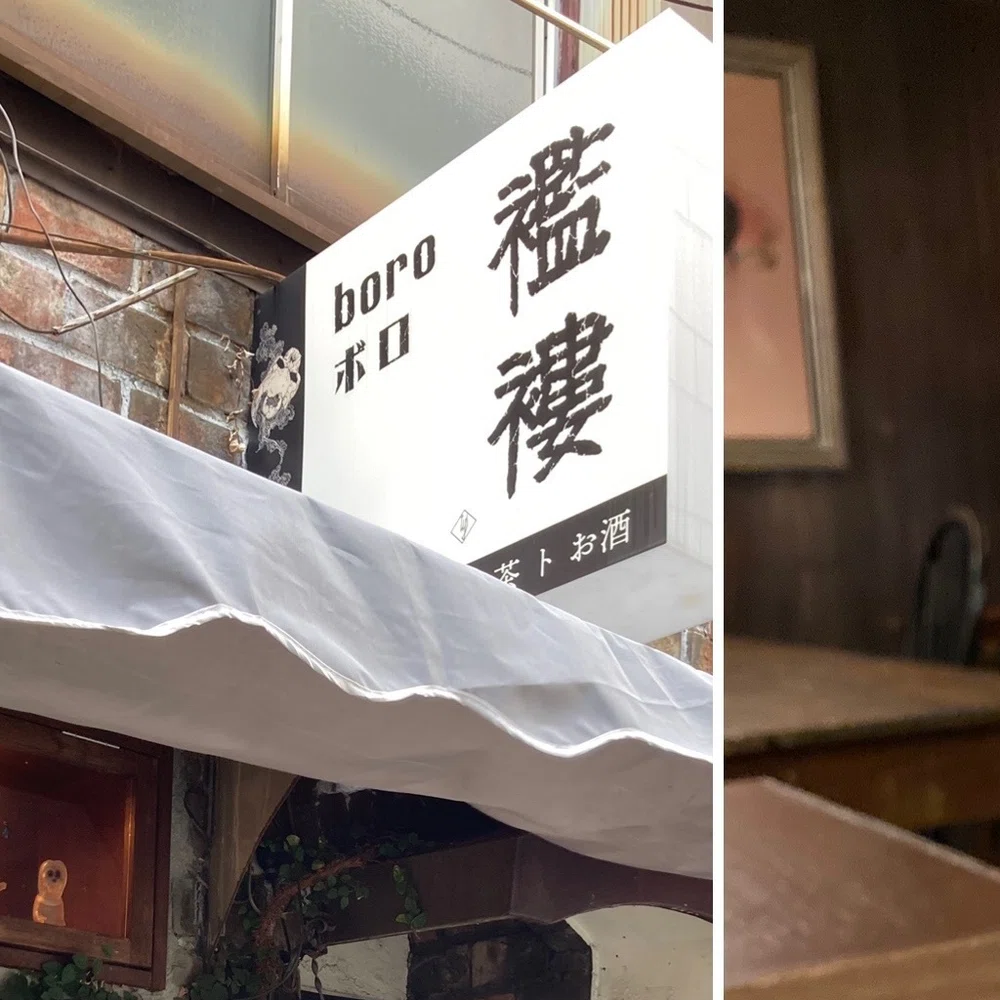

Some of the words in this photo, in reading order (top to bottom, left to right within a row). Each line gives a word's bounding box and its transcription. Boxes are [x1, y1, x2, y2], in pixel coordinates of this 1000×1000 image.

[334, 234, 436, 335] boro
[487, 122, 616, 500] 襤褸
[334, 313, 410, 395] ボロ
